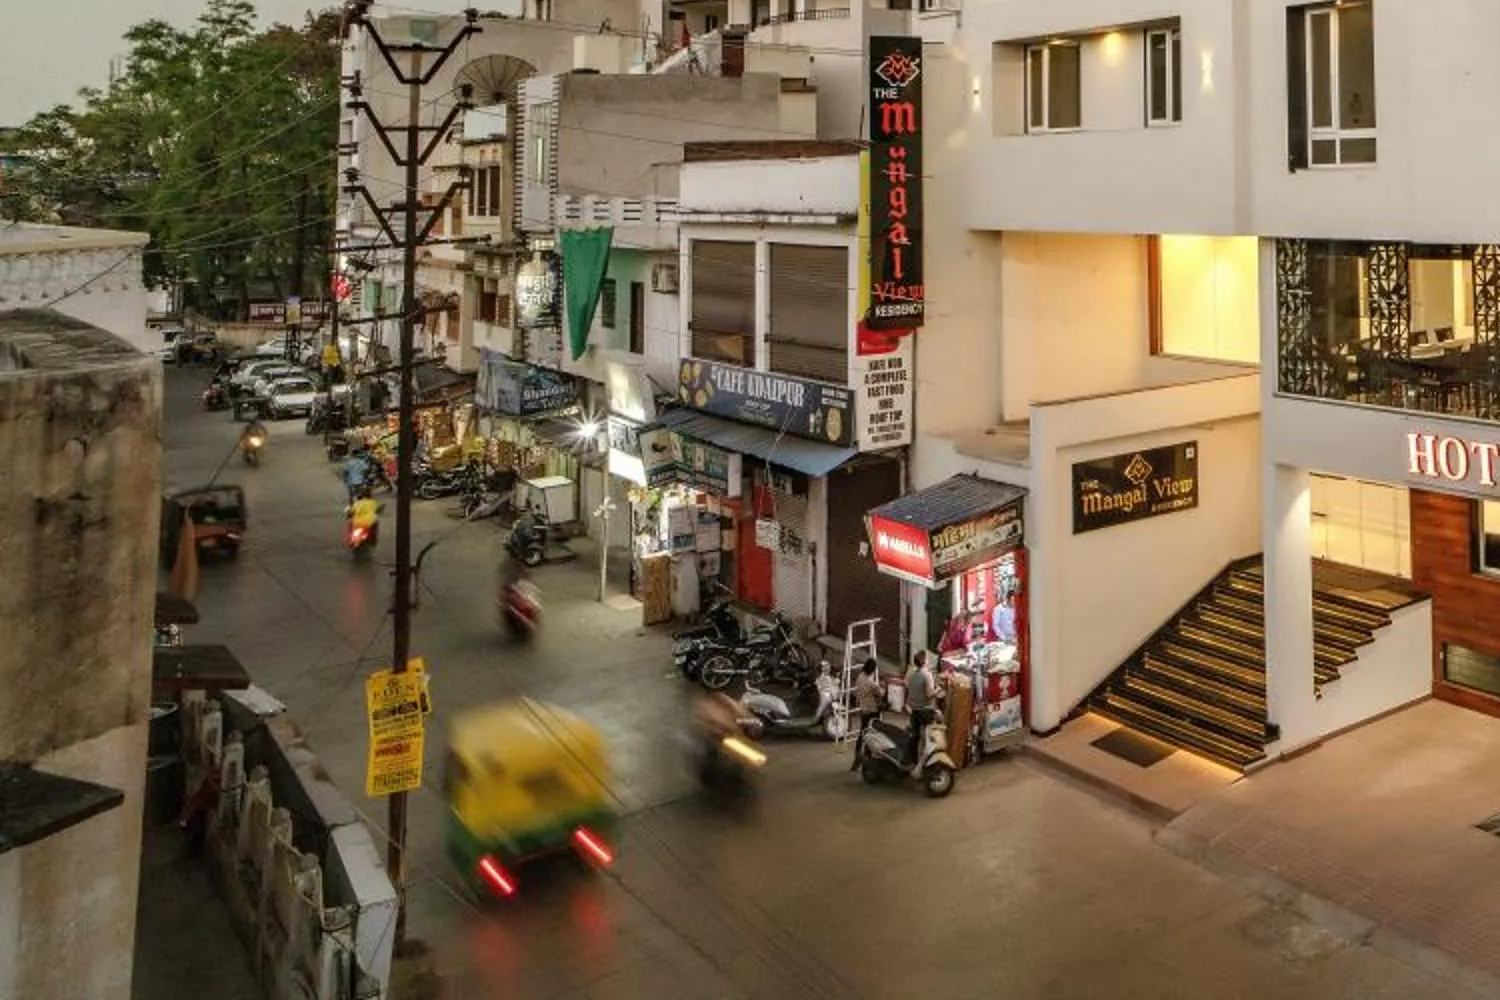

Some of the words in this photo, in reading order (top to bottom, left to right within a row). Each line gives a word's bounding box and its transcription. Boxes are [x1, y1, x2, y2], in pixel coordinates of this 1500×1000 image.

[873, 87, 899, 99] THE
[1081, 482, 1147, 515] Mangal
[1153, 477, 1193, 498] View
